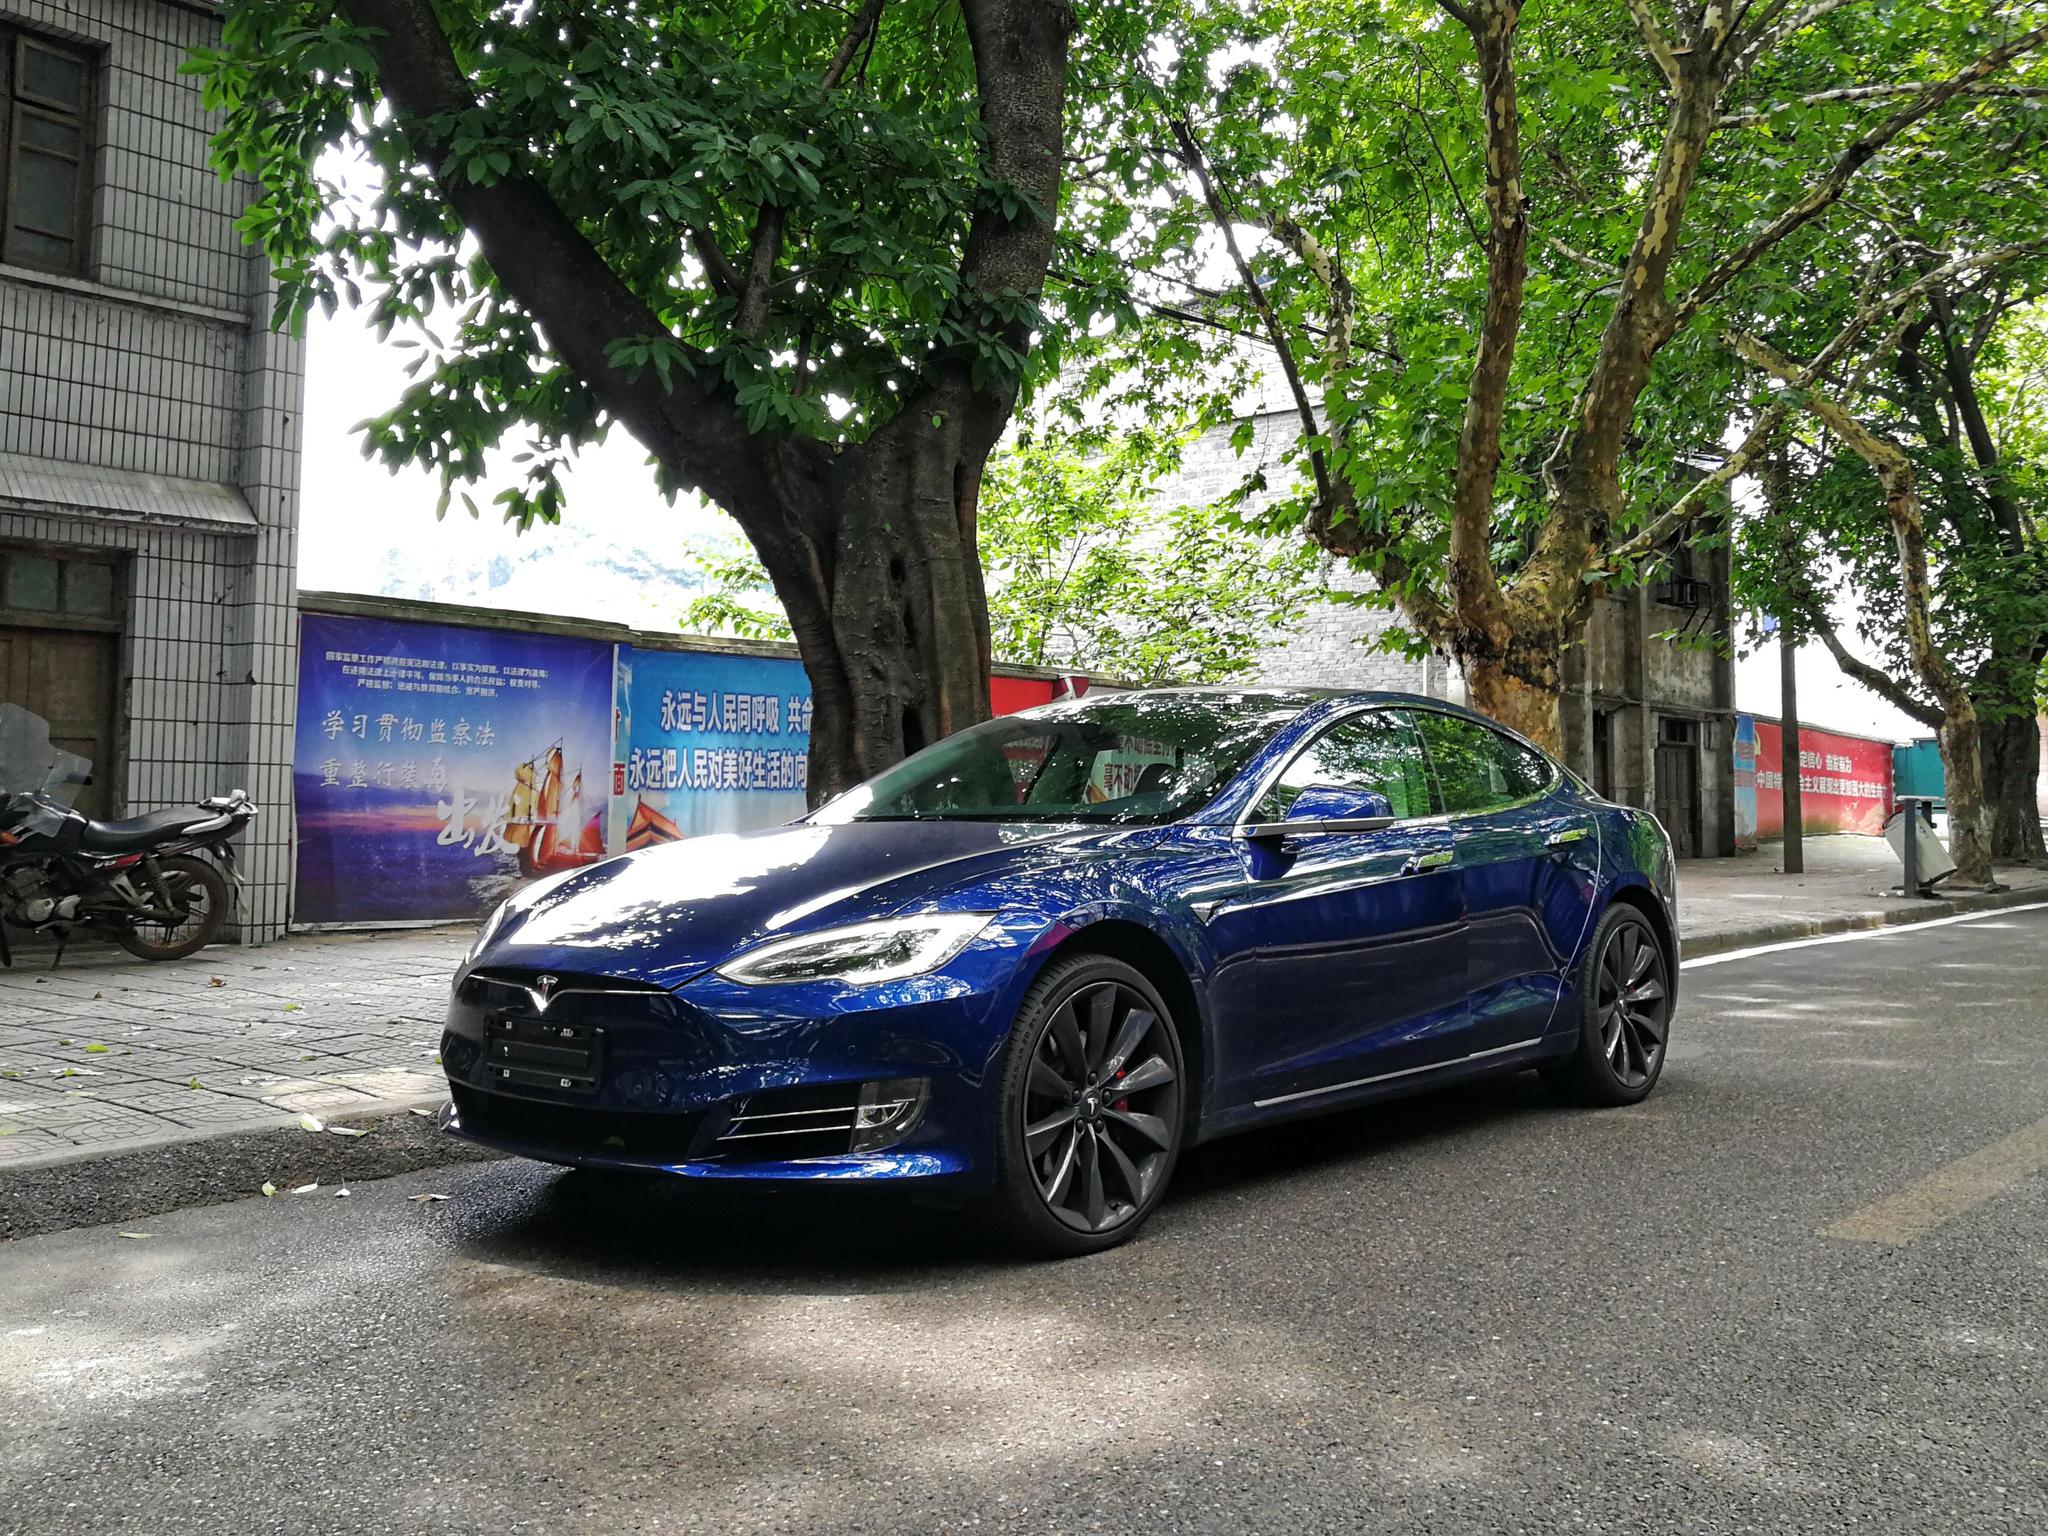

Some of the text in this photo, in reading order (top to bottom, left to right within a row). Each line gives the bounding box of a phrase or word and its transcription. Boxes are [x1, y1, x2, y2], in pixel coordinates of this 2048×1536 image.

[321, 710, 496, 748] 学习贯彻监察法
[660, 690, 780, 734] 永远与人民同呼吸
[629, 747, 808, 790] 永远把人民对美好生活的向
